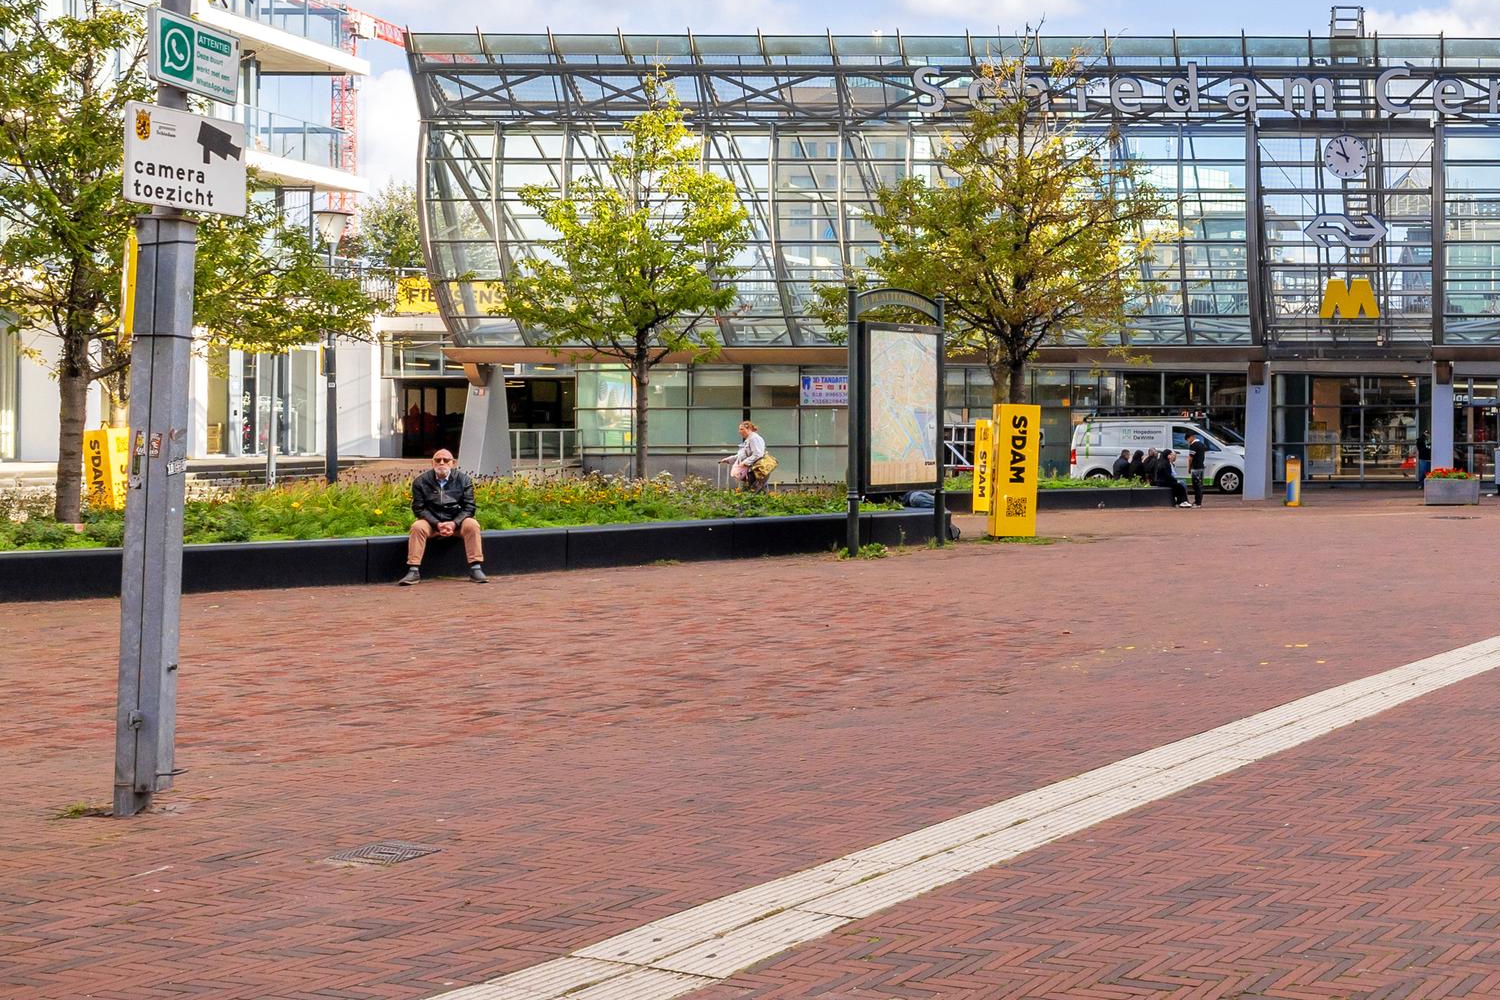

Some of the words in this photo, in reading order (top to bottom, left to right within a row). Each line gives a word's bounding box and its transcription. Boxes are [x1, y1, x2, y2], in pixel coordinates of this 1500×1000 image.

[913, 61, 1334, 114] Schiedam
[133, 179, 213, 206] toezicht
[134, 161, 205, 184] camera
[1320, 278, 1380, 319] M
[1009, 415, 1028, 484] S'DAM
[978, 450, 987, 498] S'DAM
